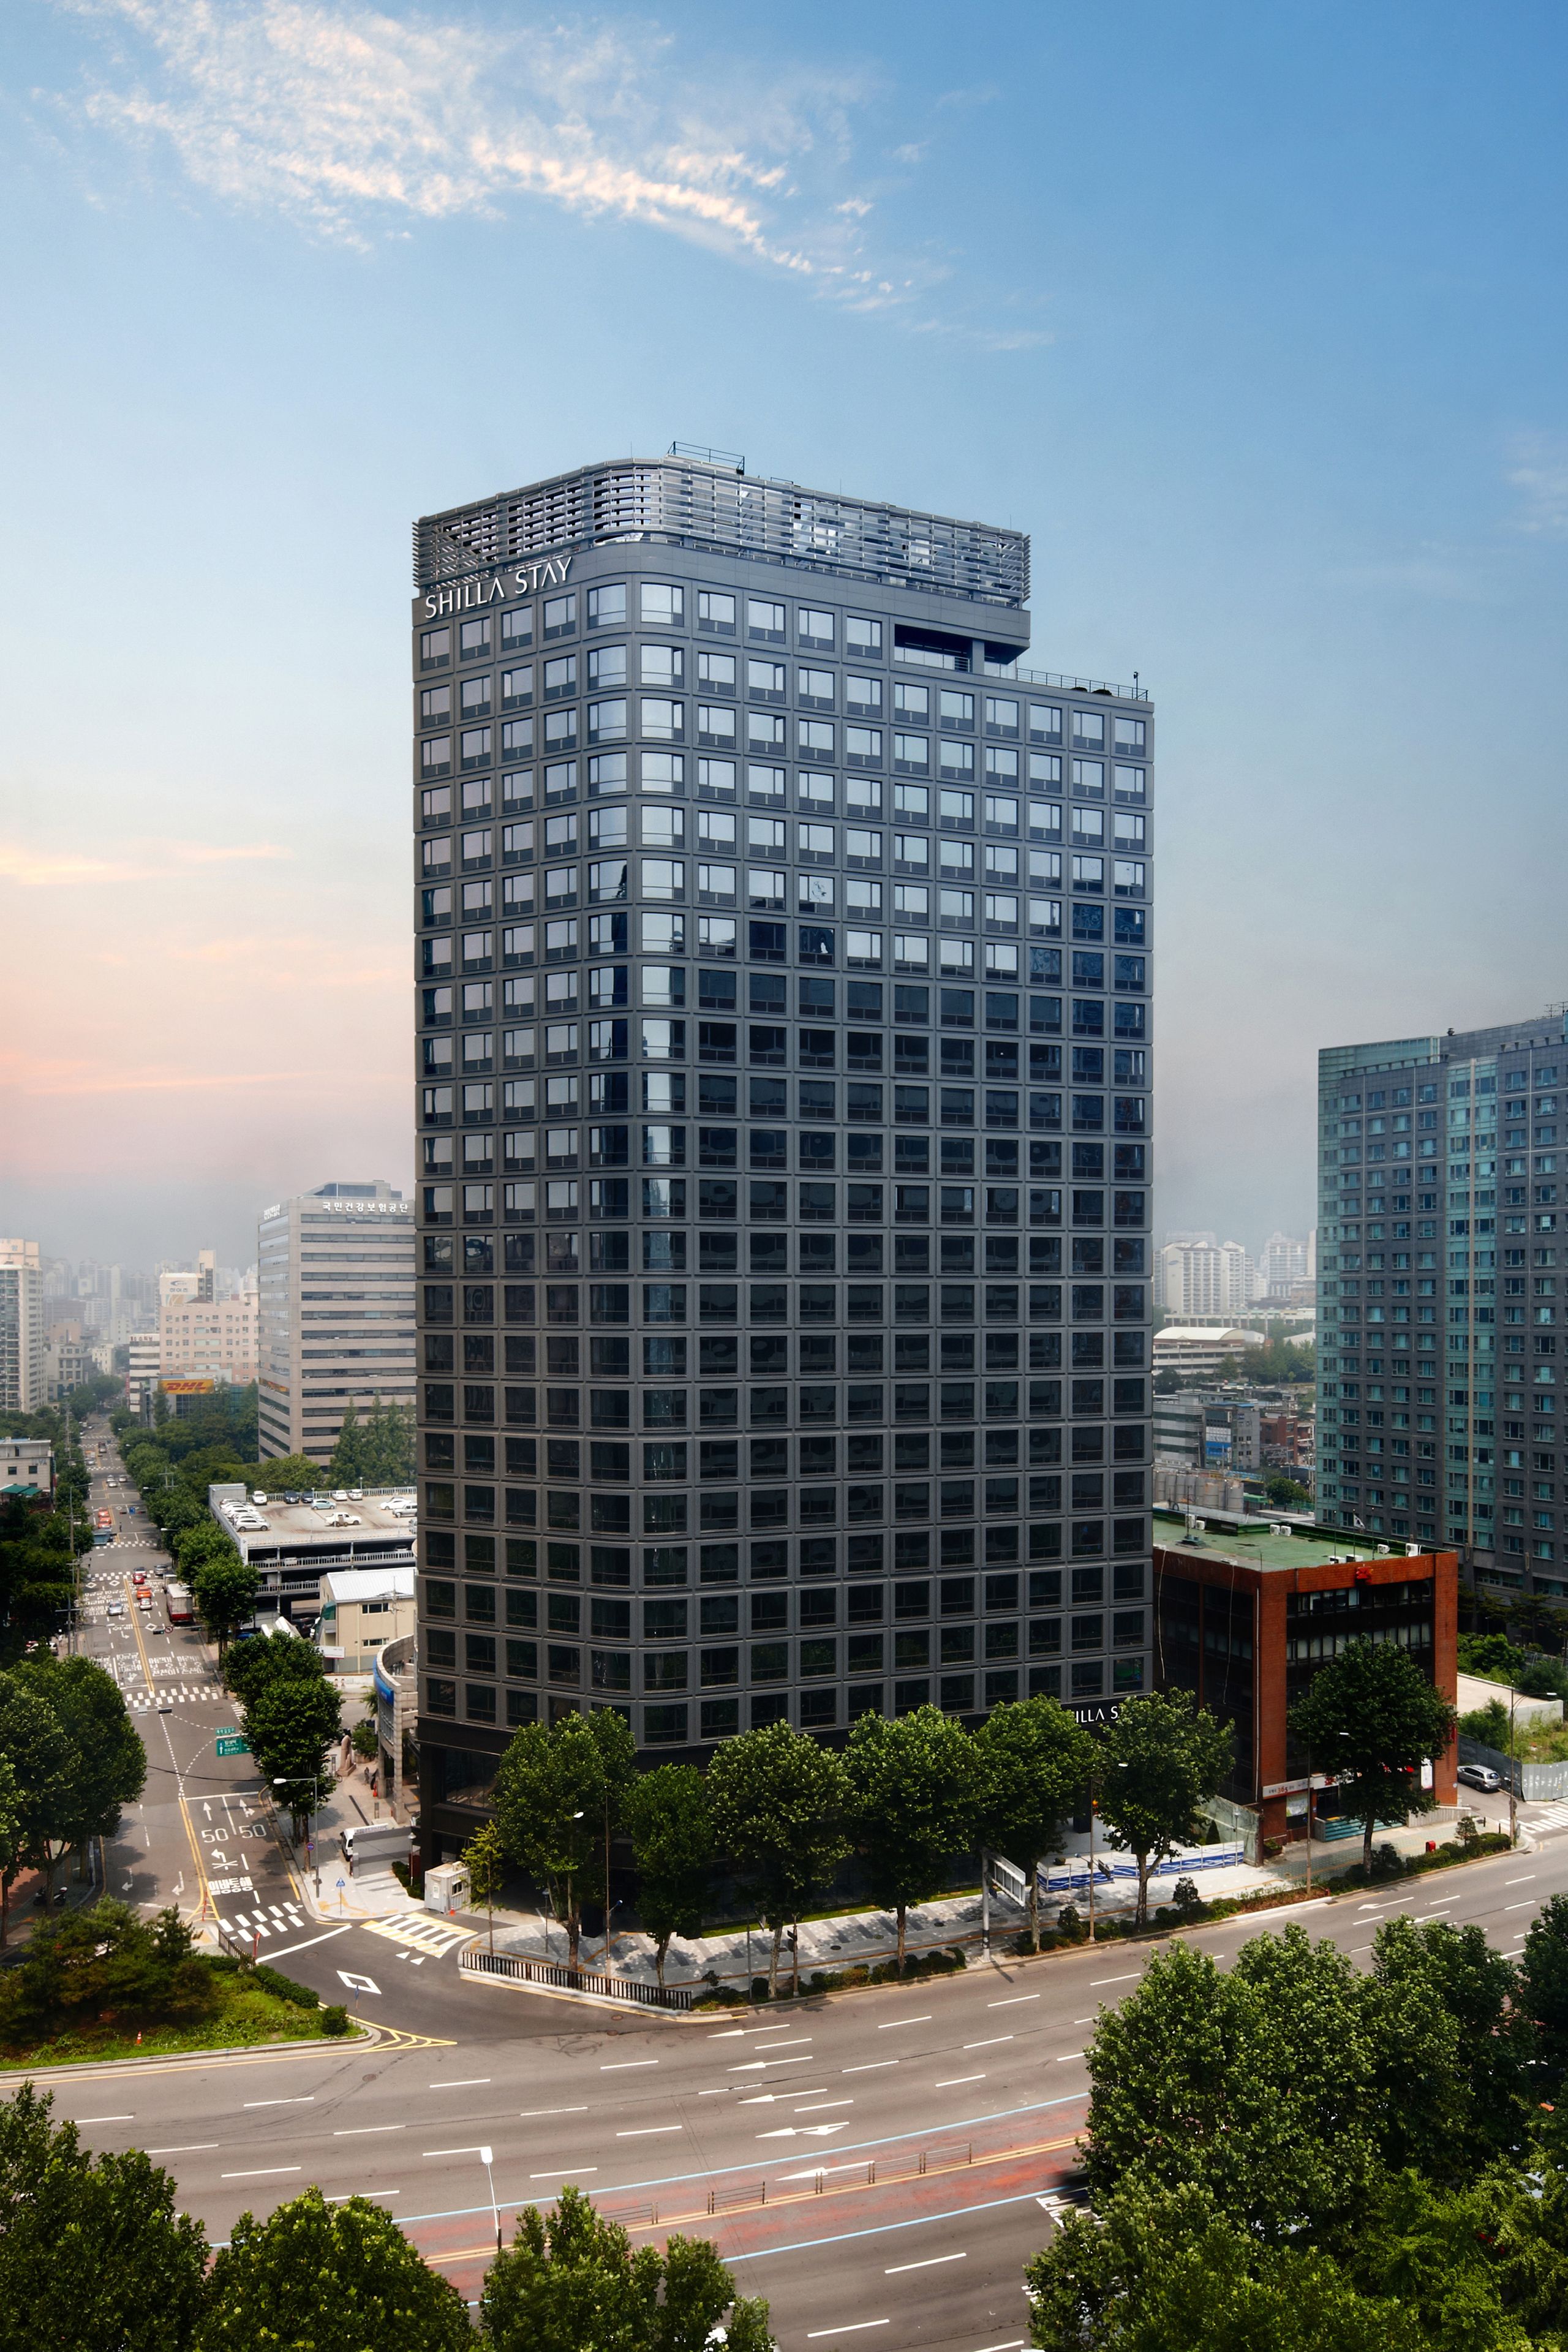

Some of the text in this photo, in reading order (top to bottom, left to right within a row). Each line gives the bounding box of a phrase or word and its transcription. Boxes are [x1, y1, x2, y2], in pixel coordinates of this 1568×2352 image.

[425, 556, 572, 619] SHILLA STAY
[322, 1202, 409, 1213] 국민건강보험공단
[166, 1382, 206, 1390] DHL
[1076, 1708, 1105, 1723] ILLA
[201, 1828, 229, 1843] 50
[238, 1824, 267, 1838] 50
[208, 1876, 254, 1896] 일방통행
